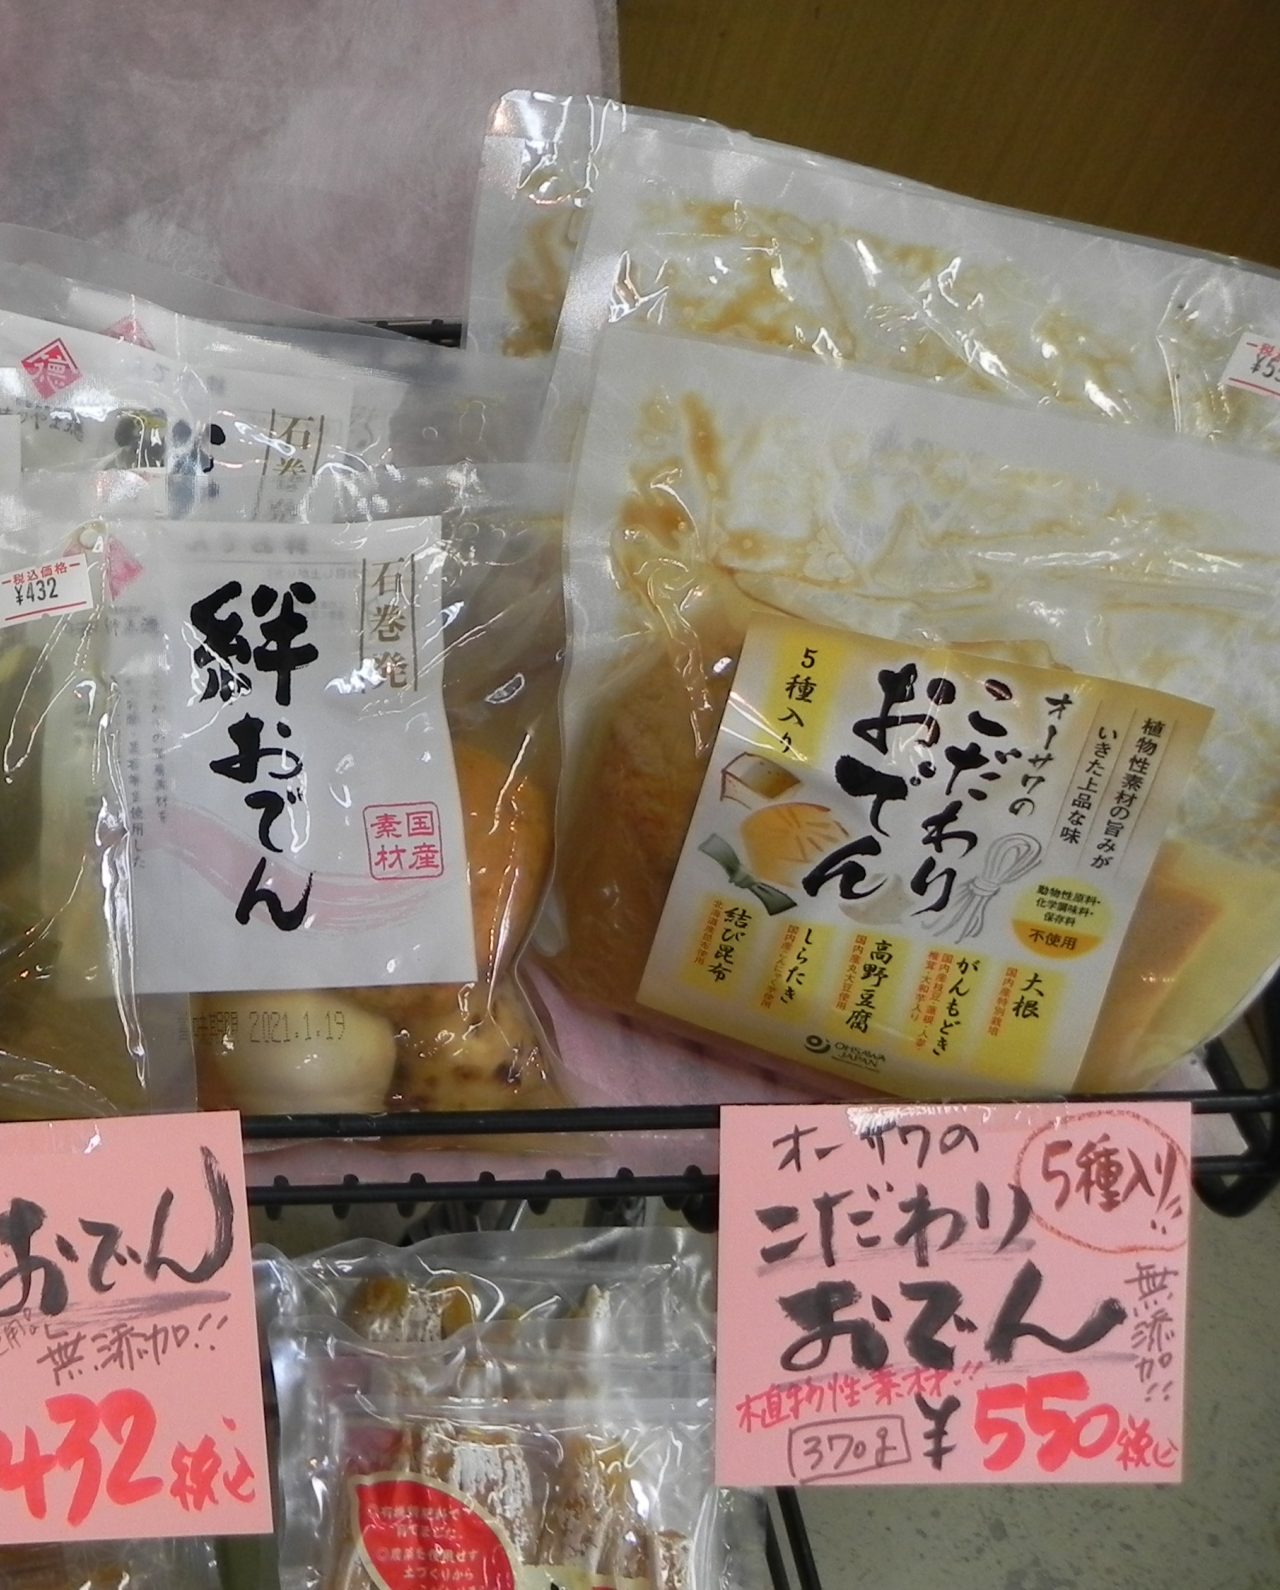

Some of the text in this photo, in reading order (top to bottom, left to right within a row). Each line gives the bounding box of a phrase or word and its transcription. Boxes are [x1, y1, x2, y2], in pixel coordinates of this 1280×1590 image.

[14, 577, 58, 605] ¥432
[370, 558, 410, 691] 石巻発
[778, 648, 818, 753] 5種入り
[190, 581, 319, 931] 絆おでん
[802, 663, 956, 899] おでん
[911, 679, 1022, 916] こだわり
[1009, 693, 1073, 816] オーサワの
[1060, 726, 1117, 845] いきた上品な味
[1090, 718, 1166, 869] 植物性素材の旨みが
[707, 906, 752, 983] 結び昆布
[780, 928, 812, 1004] しらたき
[845, 940, 894, 1033] 高野豆腐
[1028, 928, 1078, 950] 不使用
[249, 1011, 345, 1042] 2021.1.19
[932, 957, 981, 1056] がんもどき
[1013, 972, 1044, 1019] 大根
[772, 1124, 978, 1173] オーサワの
[755, 1181, 1034, 1267] こだわり
[777, 1259, 1127, 1371] おでん
[803, 1428, 898, 1470] 370g
